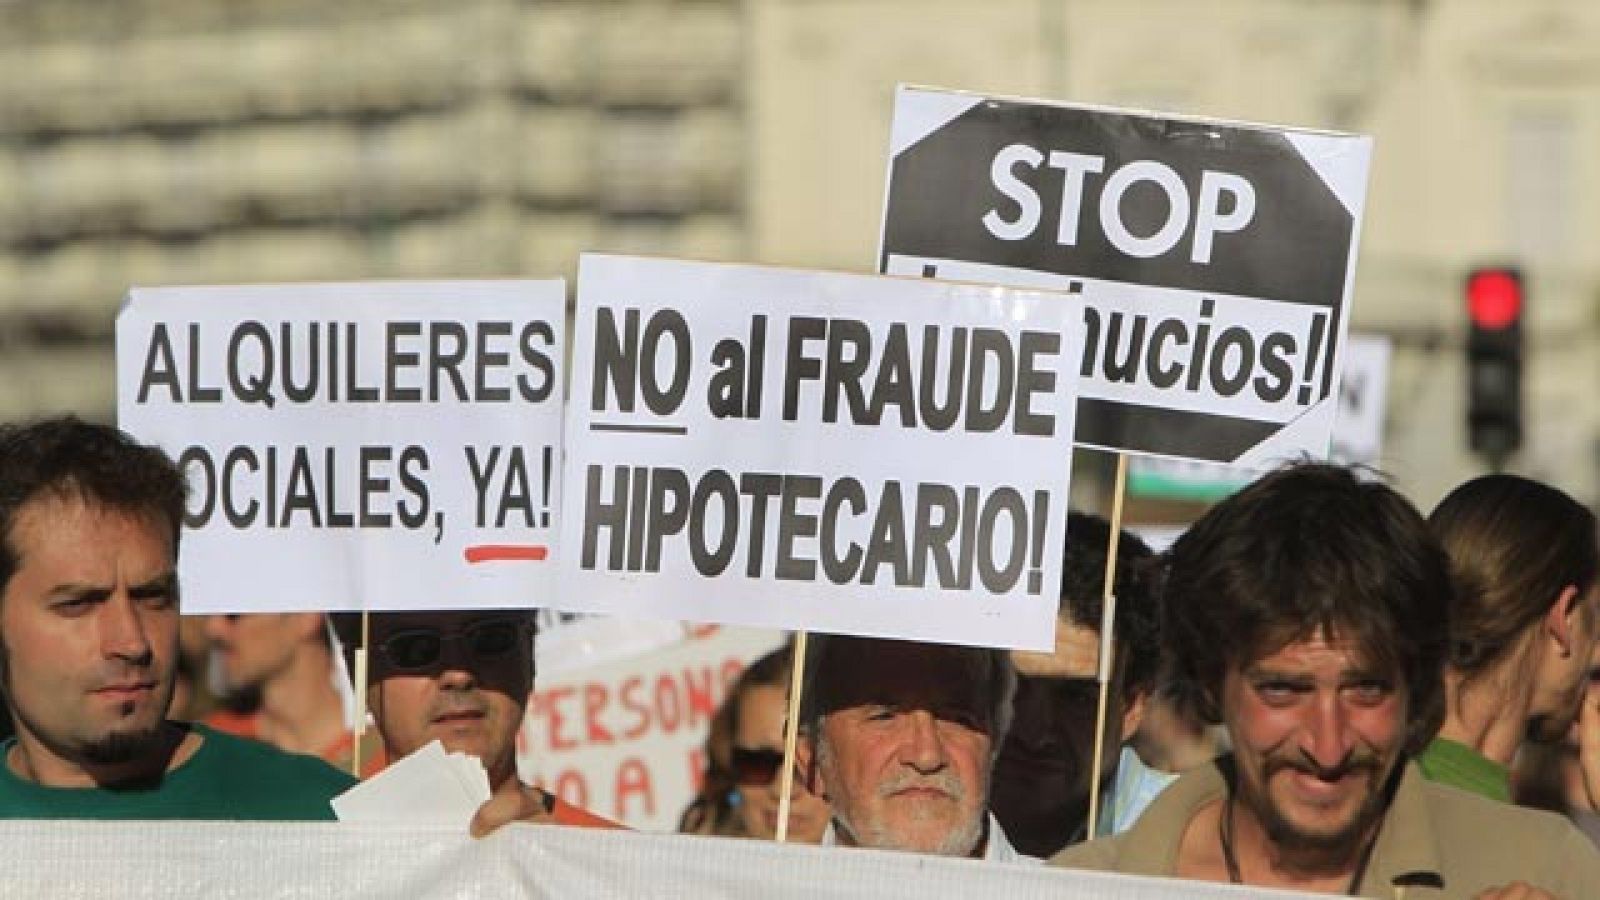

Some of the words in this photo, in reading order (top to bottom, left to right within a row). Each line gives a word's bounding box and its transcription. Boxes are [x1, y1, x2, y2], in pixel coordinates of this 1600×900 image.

[982, 144, 1256, 263] STOP
[137, 320, 556, 408] ALQUILERES
[591, 306, 691, 416] NO
[707, 314, 768, 420] al
[782, 316, 1060, 437] FRAUDE
[179, 444, 444, 544] OCIALES,
[465, 444, 552, 528] YA!
[580, 464, 1050, 595] HIPOTECARIO!
